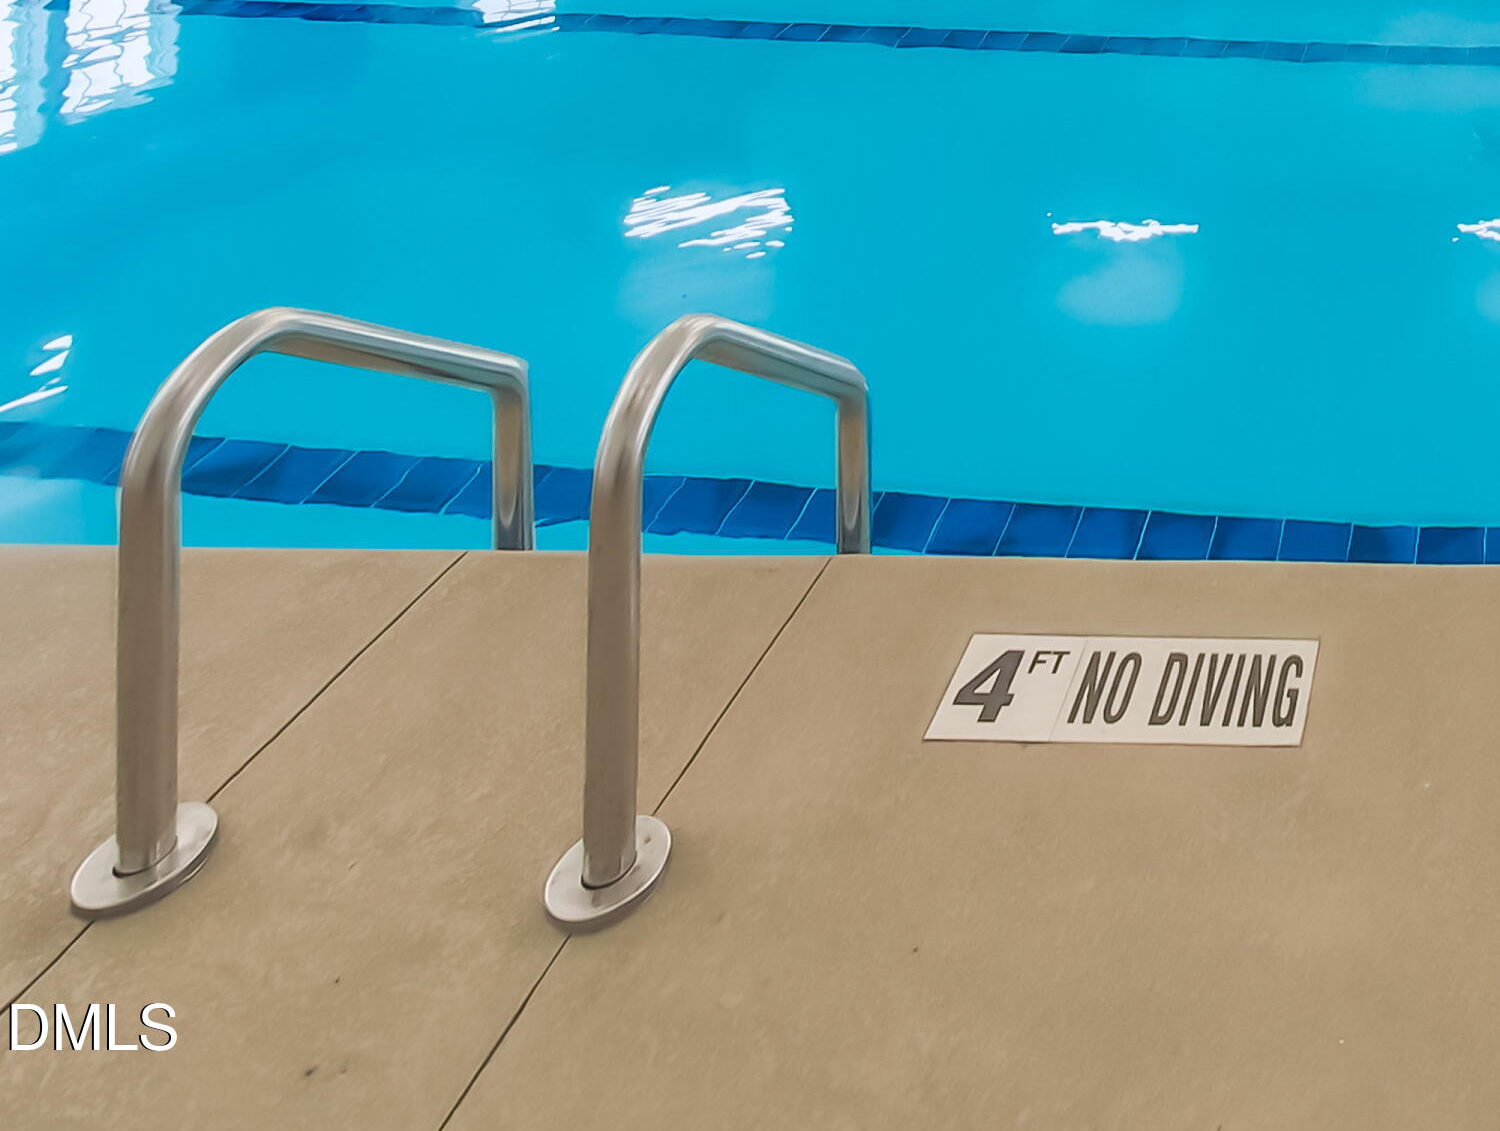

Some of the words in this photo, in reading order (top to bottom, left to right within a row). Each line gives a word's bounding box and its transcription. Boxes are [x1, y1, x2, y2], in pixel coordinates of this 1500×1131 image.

[952, 649, 1026, 723] 4
[1027, 650, 1071, 675] FT
[1067, 650, 1143, 725] NO
[1147, 652, 1304, 728] DIVING
